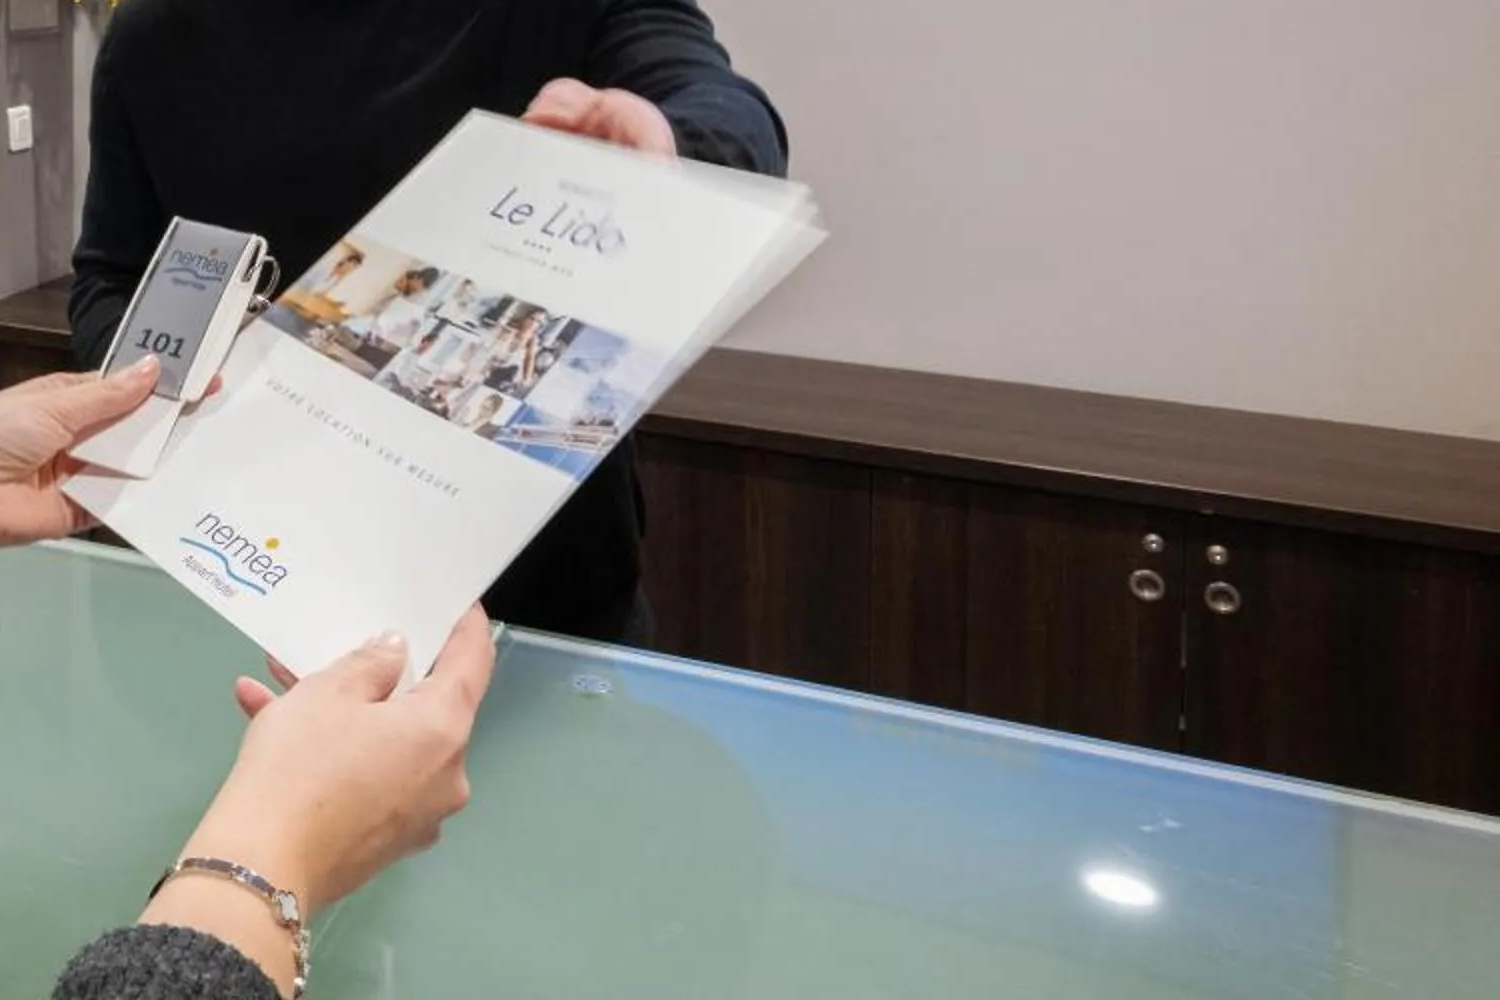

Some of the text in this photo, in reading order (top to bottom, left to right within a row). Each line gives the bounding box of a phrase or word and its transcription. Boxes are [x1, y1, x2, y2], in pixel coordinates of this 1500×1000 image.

[489, 186, 534, 225] Le
[540, 201, 626, 254] Lido
[135, 328, 185, 358] 101
[305, 403, 372, 449] LOCATION
[377, 446, 403, 466] SUR
[406, 462, 461, 498] MESURE
